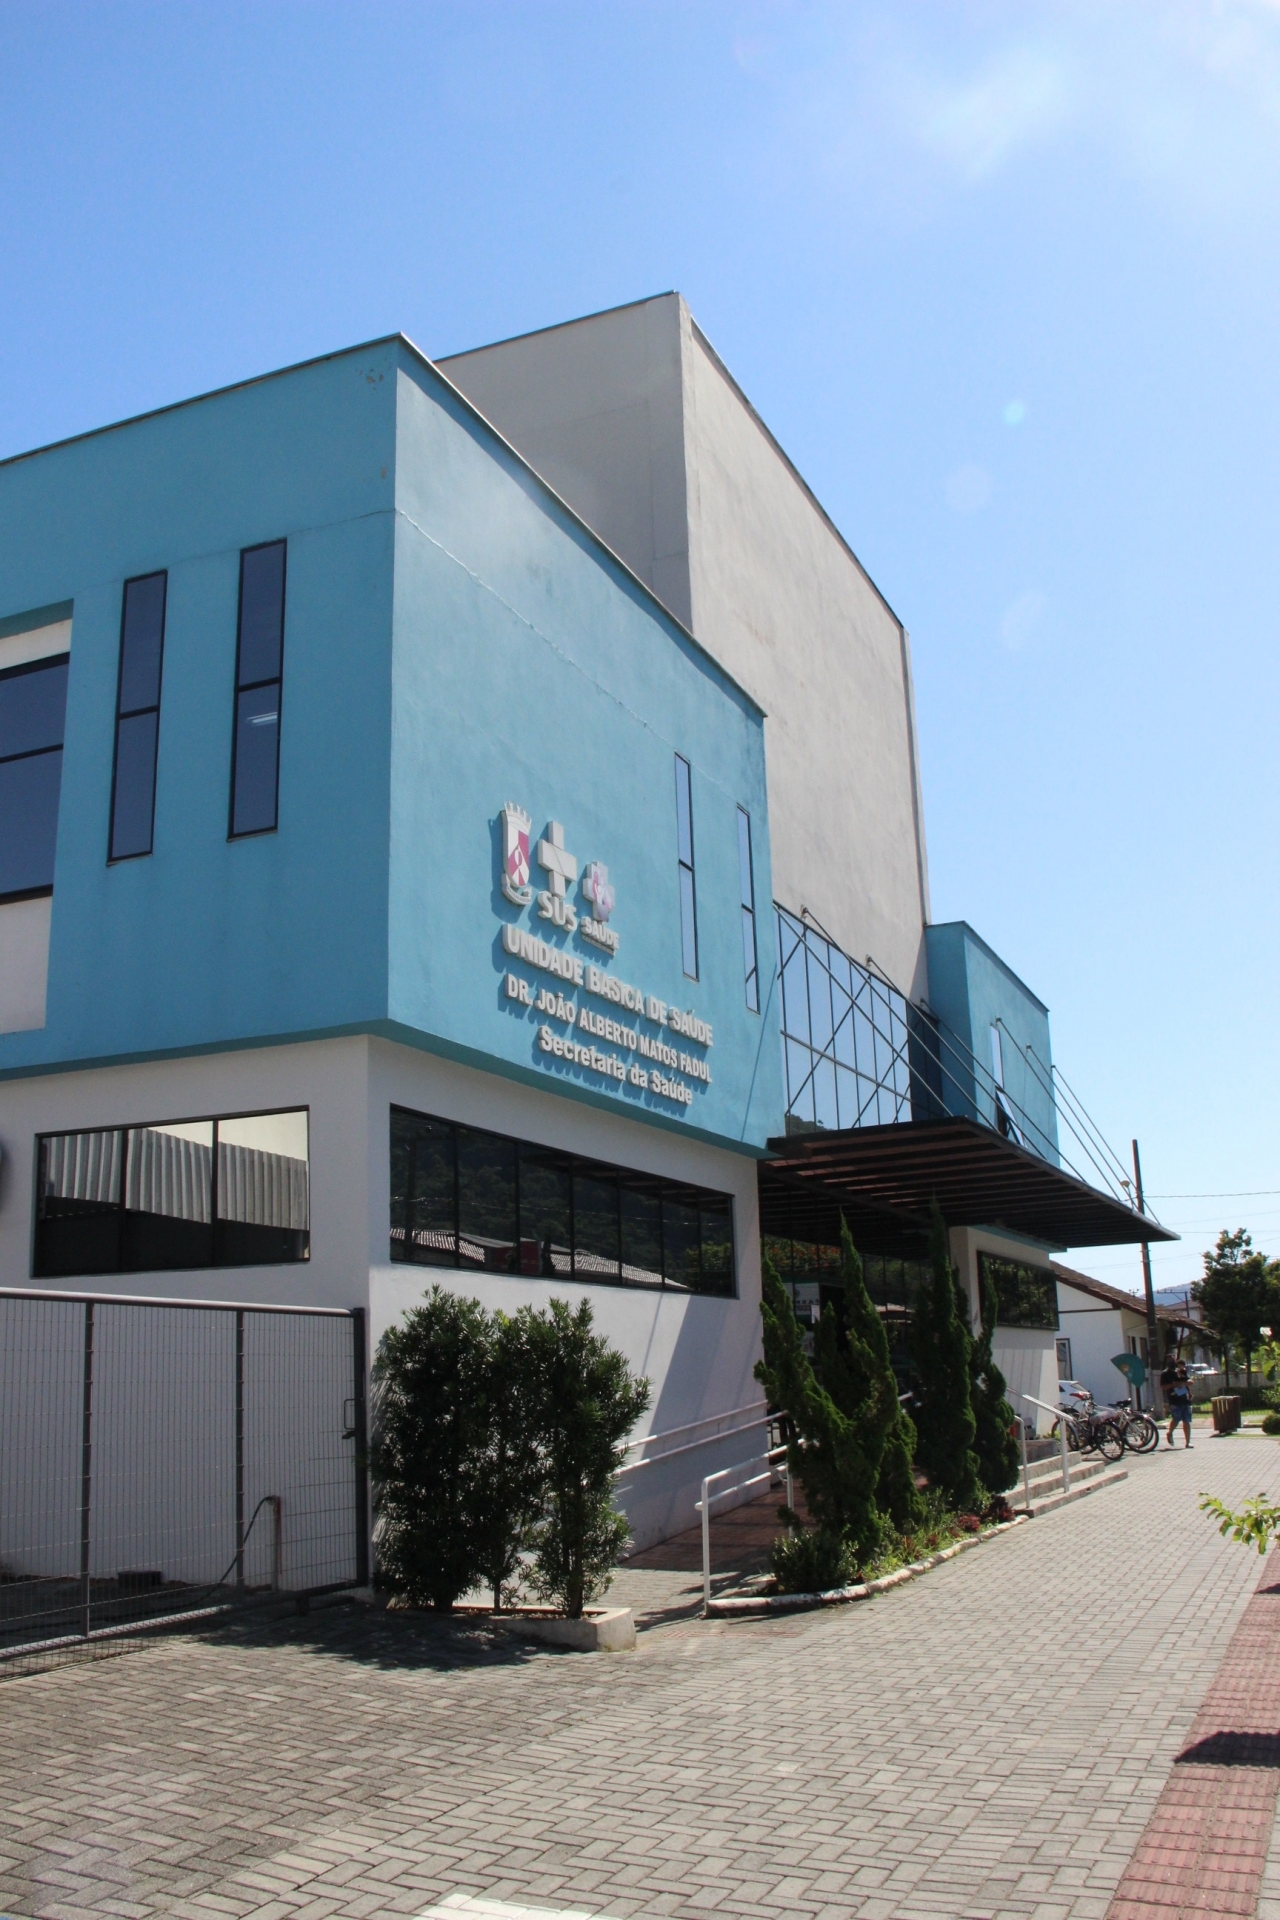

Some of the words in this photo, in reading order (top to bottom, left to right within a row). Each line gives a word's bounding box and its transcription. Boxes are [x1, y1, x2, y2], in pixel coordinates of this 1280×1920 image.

[538, 891, 577, 931] SUS
[502, 923, 583, 986] UNIDADE
[646, 996, 668, 1025] DE
[669, 1008, 713, 1047] SAÚDE
[505, 973, 533, 1006] DR.
[535, 989, 576, 1023] JOÃO
[578, 1008, 637, 1050] ALBERTO
[638, 1034, 678, 1068] MATOS
[679, 1052, 712, 1083] FADUL
[539, 1025, 626, 1080] Secretaria
[627, 1063, 648, 1088] da
[650, 1071, 692, 1105] Saúde
